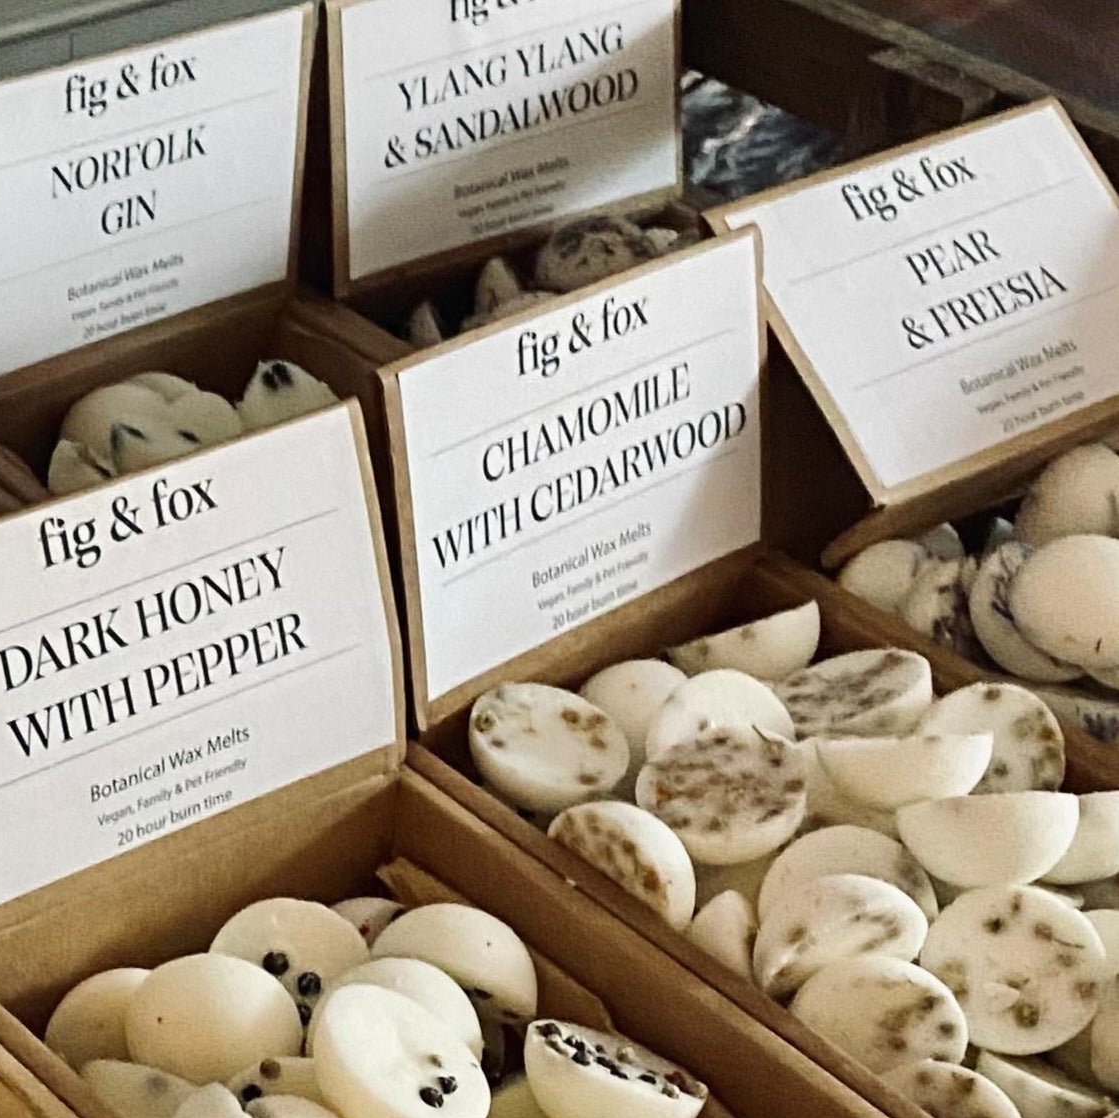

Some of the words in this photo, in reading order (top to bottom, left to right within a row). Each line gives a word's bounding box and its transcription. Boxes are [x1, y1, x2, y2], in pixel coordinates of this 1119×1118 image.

[66, 74, 107, 117] fig
[116, 64, 139, 98] &
[151, 54, 197, 91] fox
[399, 56, 507, 112] YLANG
[516, 23, 623, 78] YLANG
[384, 135, 408, 169] &
[415, 69, 638, 158] SANDALWOOD
[51, 125, 206, 199] NORFOLK
[841, 184, 898, 222] fig
[892, 167, 924, 202] &
[920, 155, 978, 192] fox
[101, 190, 156, 235] GIN
[905, 229, 1001, 286] PEAR
[517, 331, 560, 378] fig
[569, 312, 592, 353] &
[601, 297, 649, 343] fox
[901, 314, 935, 349] &
[928, 265, 1068, 338] FREESIA
[482, 363, 691, 482] CHAMOMILE
[38, 517, 102, 569] fig
[110, 495, 144, 542] &
[152, 478, 219, 528] fox
[433, 497, 522, 569] WITH
[531, 401, 747, 522] CEDARWOOD
[134, 546, 287, 640] HONEY
[532, 546, 589, 588] Botanical
[591, 540, 617, 560] Wax
[619, 521, 651, 546] Melts
[6, 677, 138, 758] WITH
[144, 613, 308, 707] PEPPER
[90, 756, 166, 803] Botanical
[168, 749, 203, 770] Wax
[207, 727, 250, 755] Melts
[175, 783, 183, 795] &
[185, 775, 202, 791] Pet
[117, 830, 133, 847] 20
[136, 816, 167, 838] hour
[170, 803, 201, 824] burn
[203, 790, 232, 810] time
